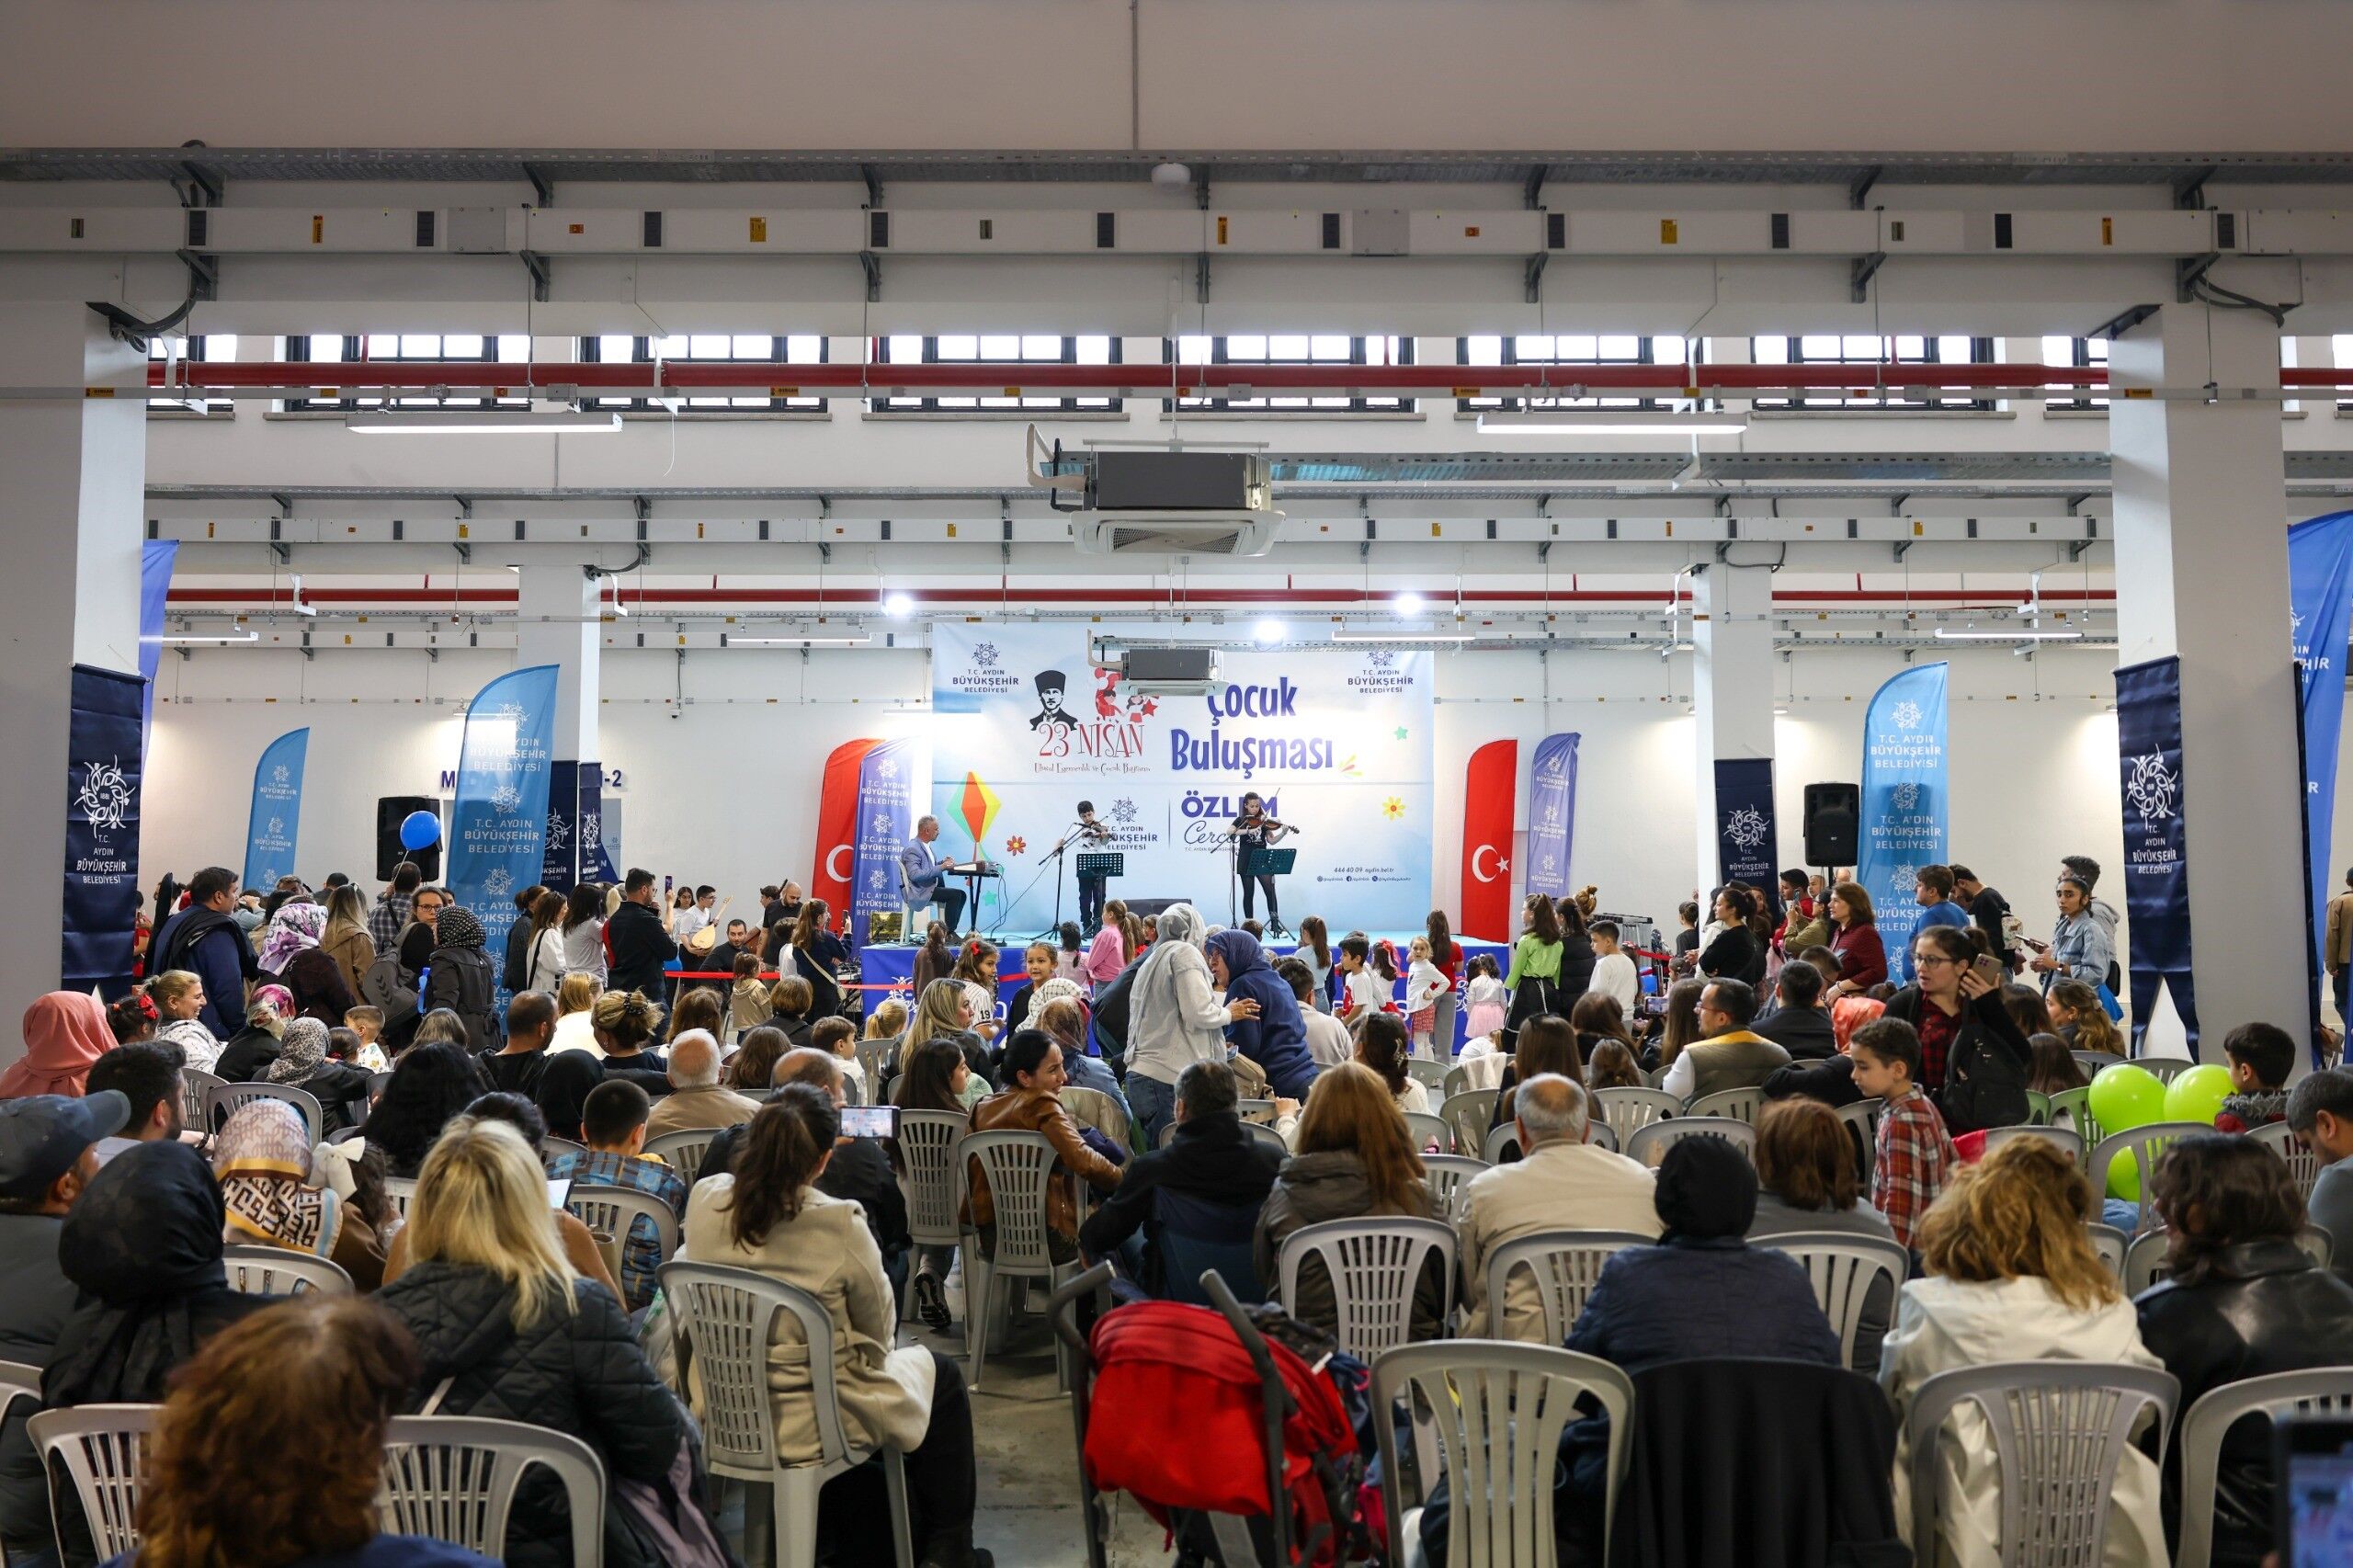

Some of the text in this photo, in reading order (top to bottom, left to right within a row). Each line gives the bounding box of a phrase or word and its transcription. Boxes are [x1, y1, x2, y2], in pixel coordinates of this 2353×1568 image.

[952, 676, 1019, 687] BÜYÜKŞEHİR
[1347, 676, 1414, 686] BÜYÜKŞEHİR
[1207, 676, 1297, 726] Çocuk
[1039, 717, 1145, 757] 23 NİSAN
[1904, 735, 1934, 744] AYDIN
[1171, 729, 1333, 779] Buluşması
[1870, 744, 1941, 757] BÜYÜKŞEHİR
[500, 819, 532, 828] AYDIN
[1871, 825, 1941, 838] BÜYÜKŞEHİR
[464, 830, 540, 844] BÜYÜKŞEHİR
[1113, 833, 1158, 843] KŞEHİR
[1876, 839, 1938, 849] BELEDİYESİ
[94, 847, 114, 856] AYDIN
[2132, 847, 2177, 864] BÜYÜKŞEHİR
[77, 858, 127, 874] BÜYÜKŞEHİR
[1729, 862, 1769, 871] BÜYÜKŞEHİR
[2138, 864, 2173, 874] BELEDİYESİ
[83, 875, 121, 884] BELEDİYESİ
[857, 900, 900, 908] BÜYÜKŞEHİR
[1875, 922, 1915, 931] BELEDİ
[980, 1010, 991, 1019] 19
